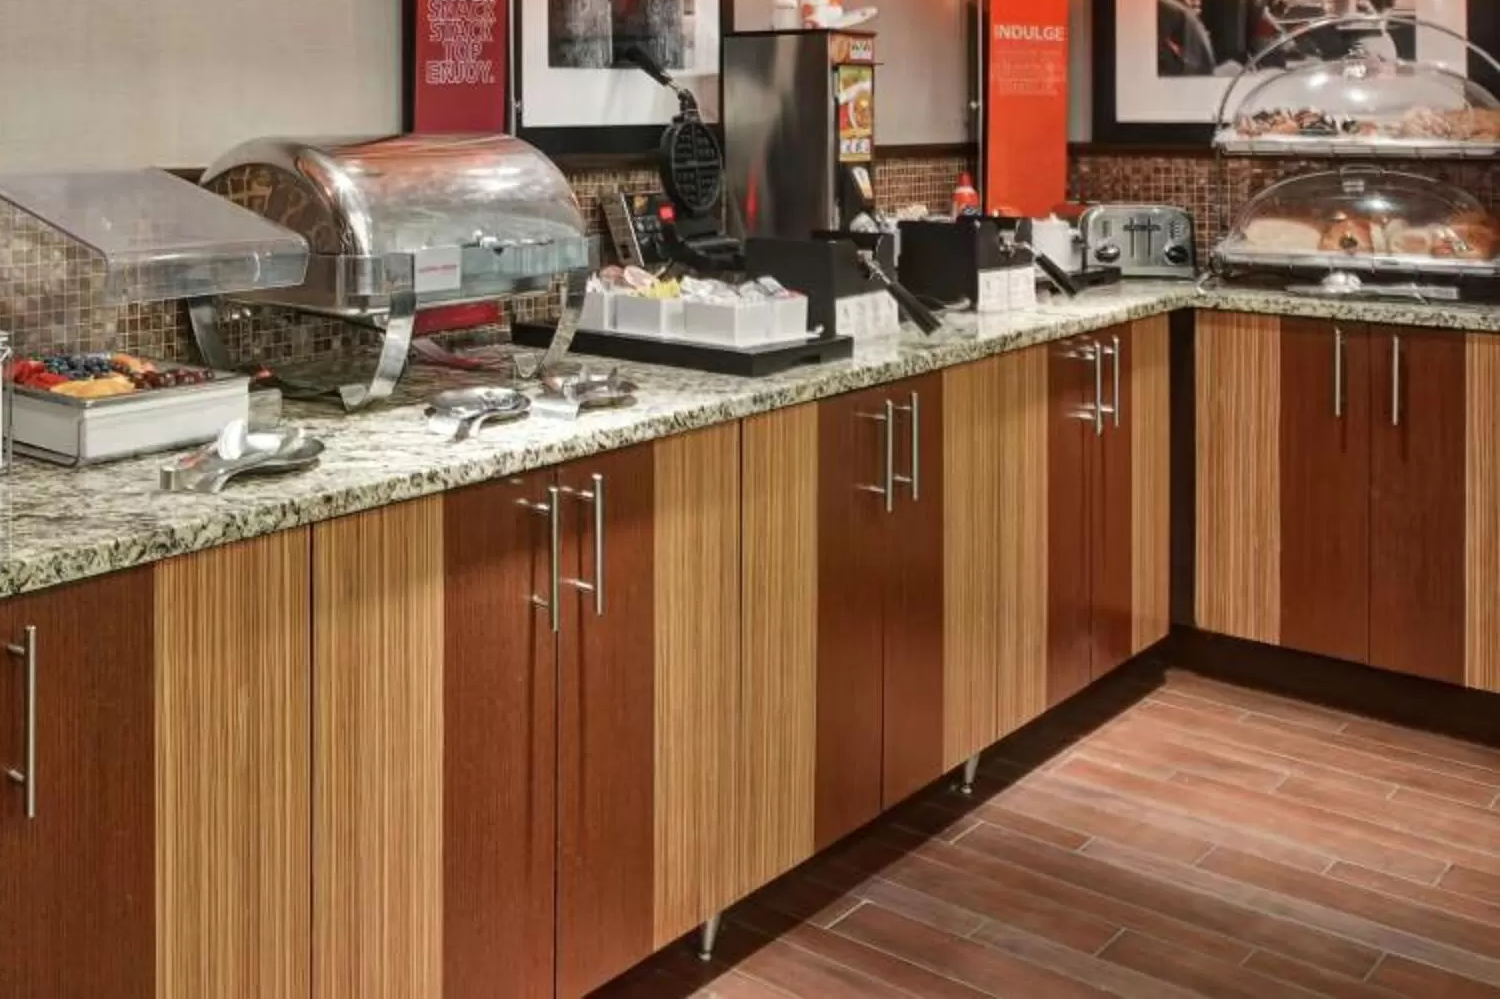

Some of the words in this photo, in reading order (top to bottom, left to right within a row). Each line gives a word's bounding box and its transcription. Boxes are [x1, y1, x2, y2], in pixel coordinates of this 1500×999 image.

[428, 20, 494, 42] STACK
[994, 24, 1064, 42] INDULGE
[441, 40, 483, 62] TOP
